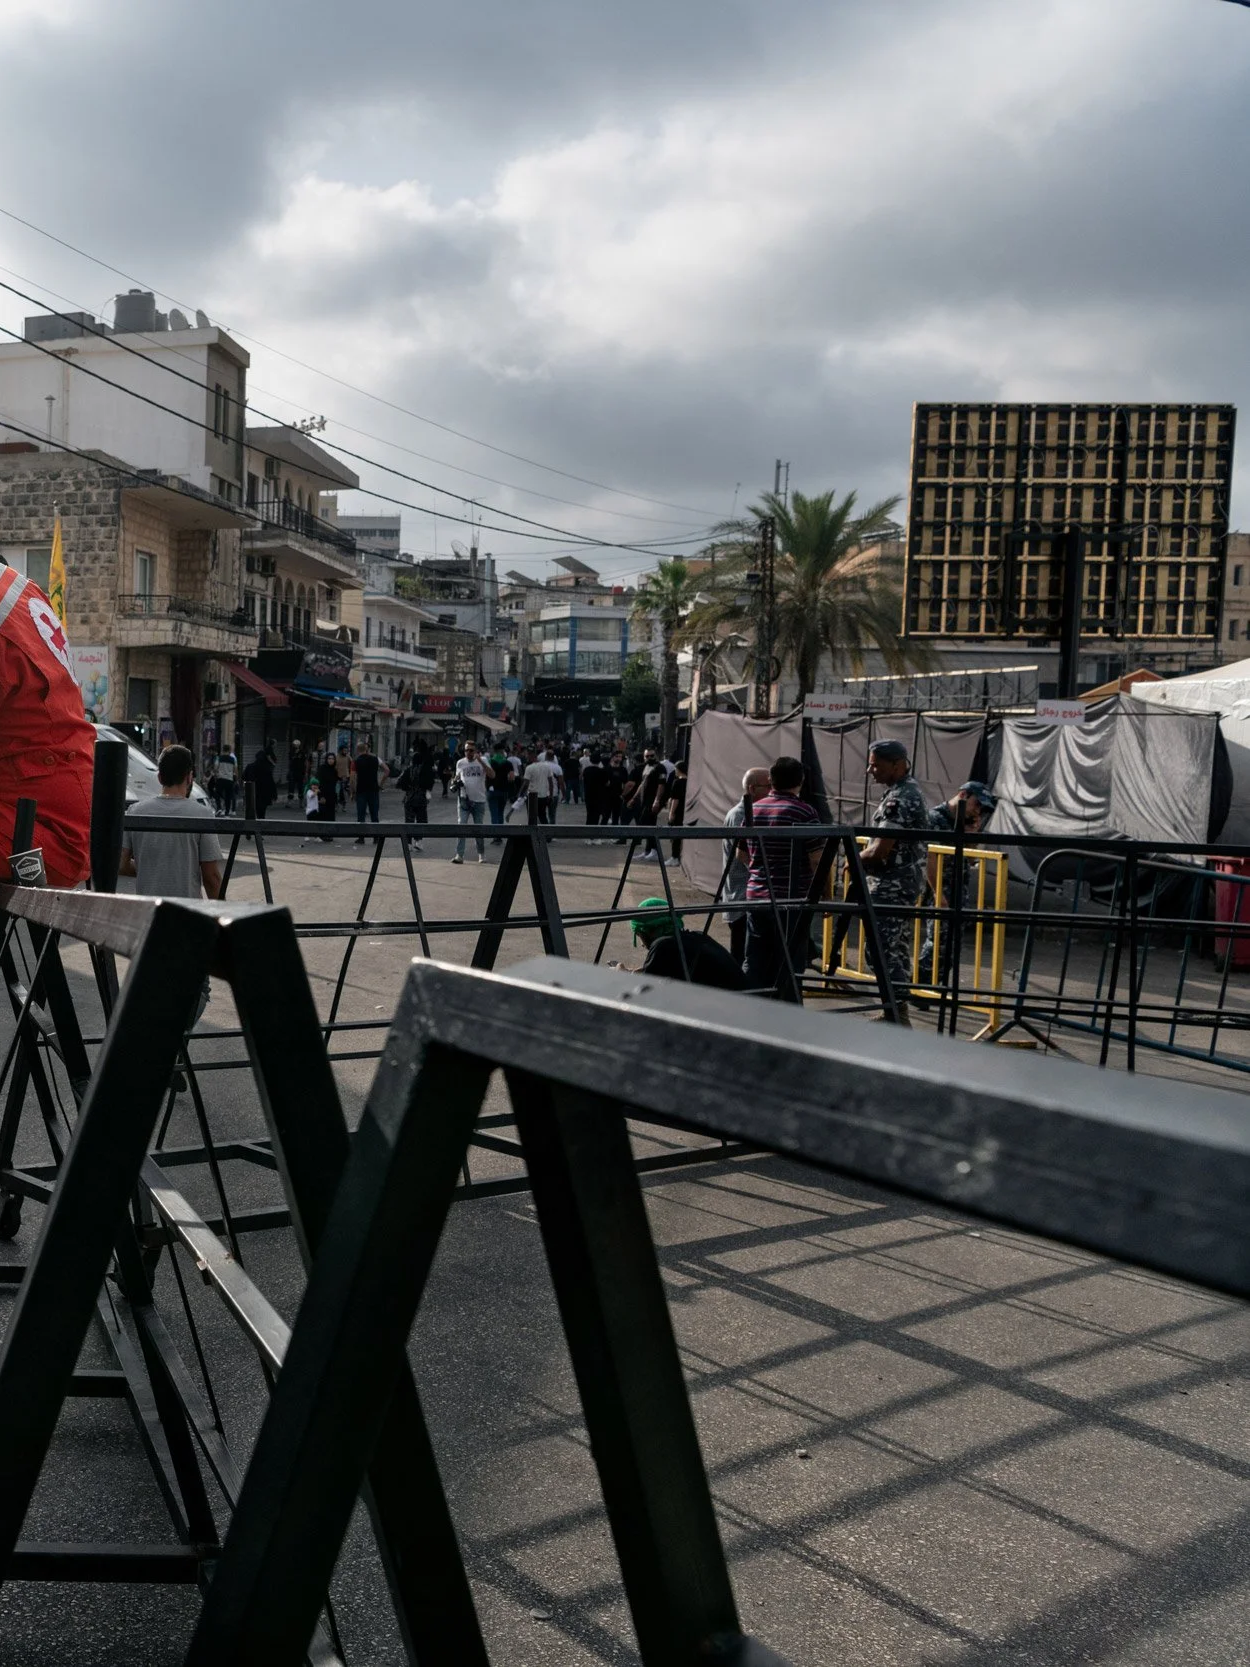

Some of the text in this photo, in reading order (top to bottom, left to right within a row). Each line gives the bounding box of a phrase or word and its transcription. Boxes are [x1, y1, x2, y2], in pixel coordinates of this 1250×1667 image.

[805, 701, 848, 711] خروج نساء
[1038, 707, 1083, 719] خروج رجال
